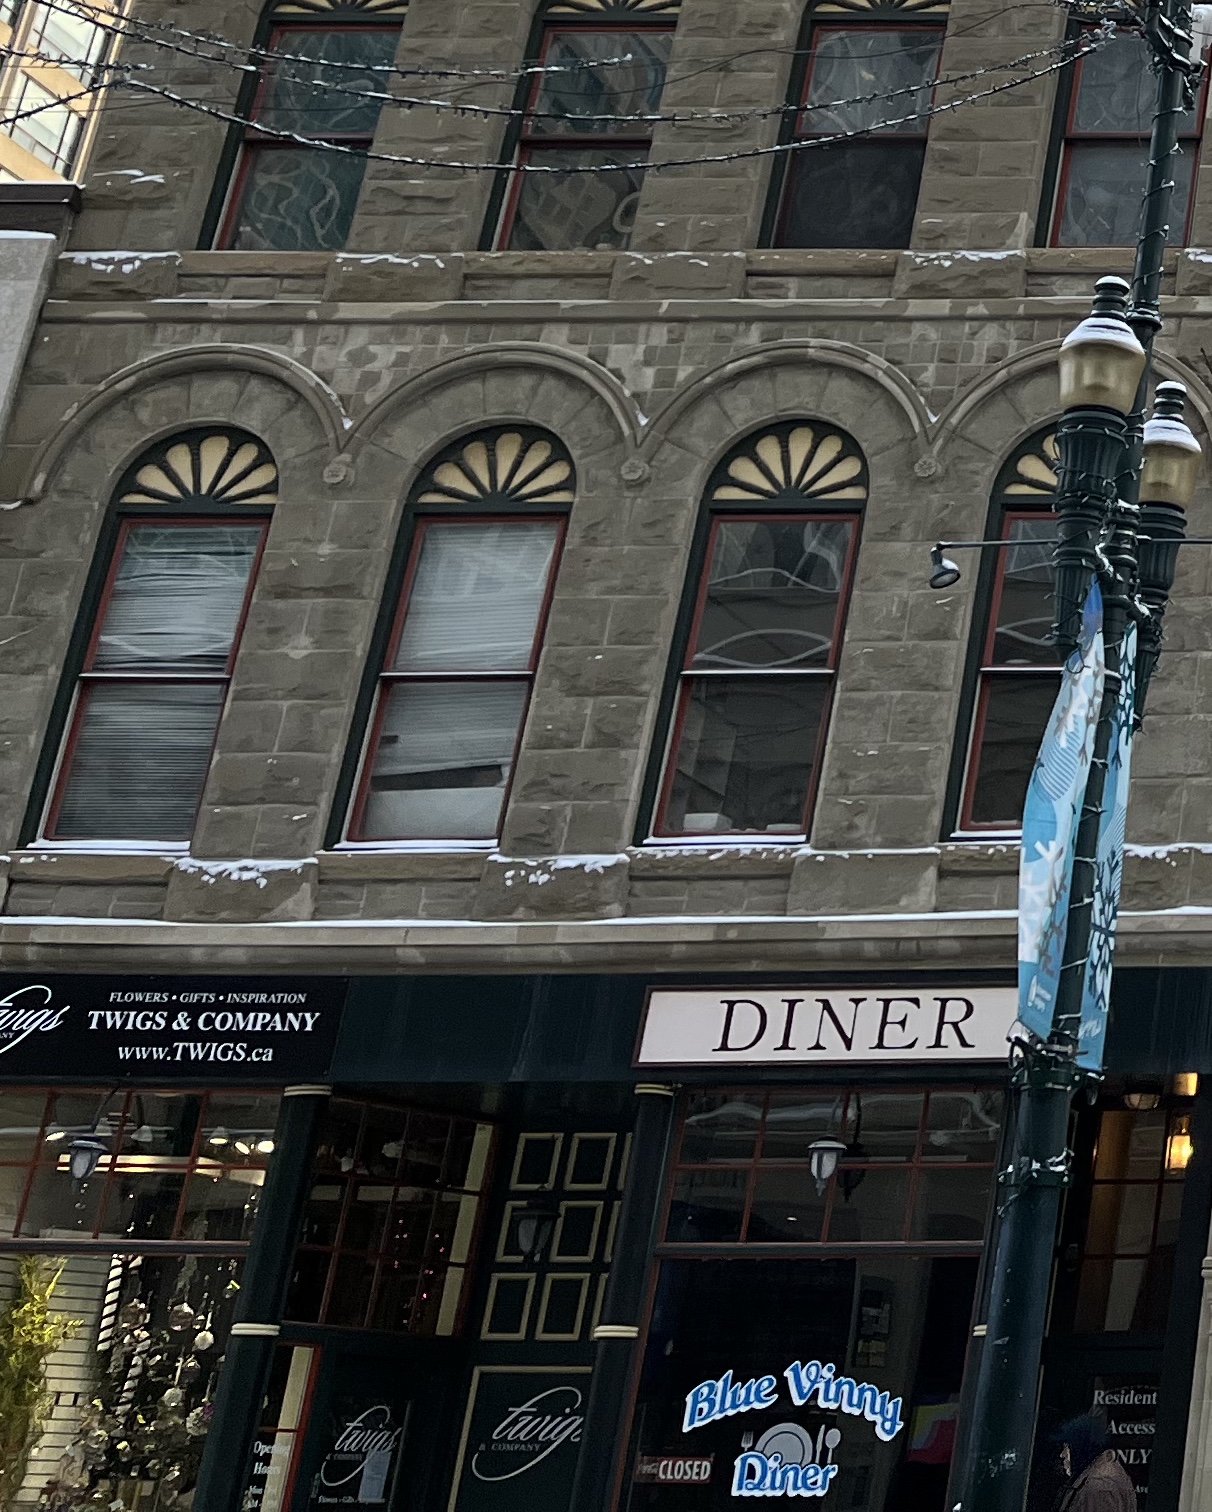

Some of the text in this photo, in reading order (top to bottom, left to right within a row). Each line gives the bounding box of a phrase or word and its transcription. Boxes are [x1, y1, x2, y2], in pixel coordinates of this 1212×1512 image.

[109, 992, 307, 1004] FLOWERS GIFTS INSPIRATION
[87, 1010, 321, 1032] TWIGS & COMPANY
[712, 997, 976, 1052] DINER
[118, 1042, 273, 1062] www.TWIGS.ca
[682, 1360, 904, 1442] Blue Vinny
[1093, 1389, 1158, 1405] Resident
[1105, 1419, 1156, 1435] Access
[658, 1460, 712, 1481] CLOSED
[731, 1451, 838, 1498] Diner
